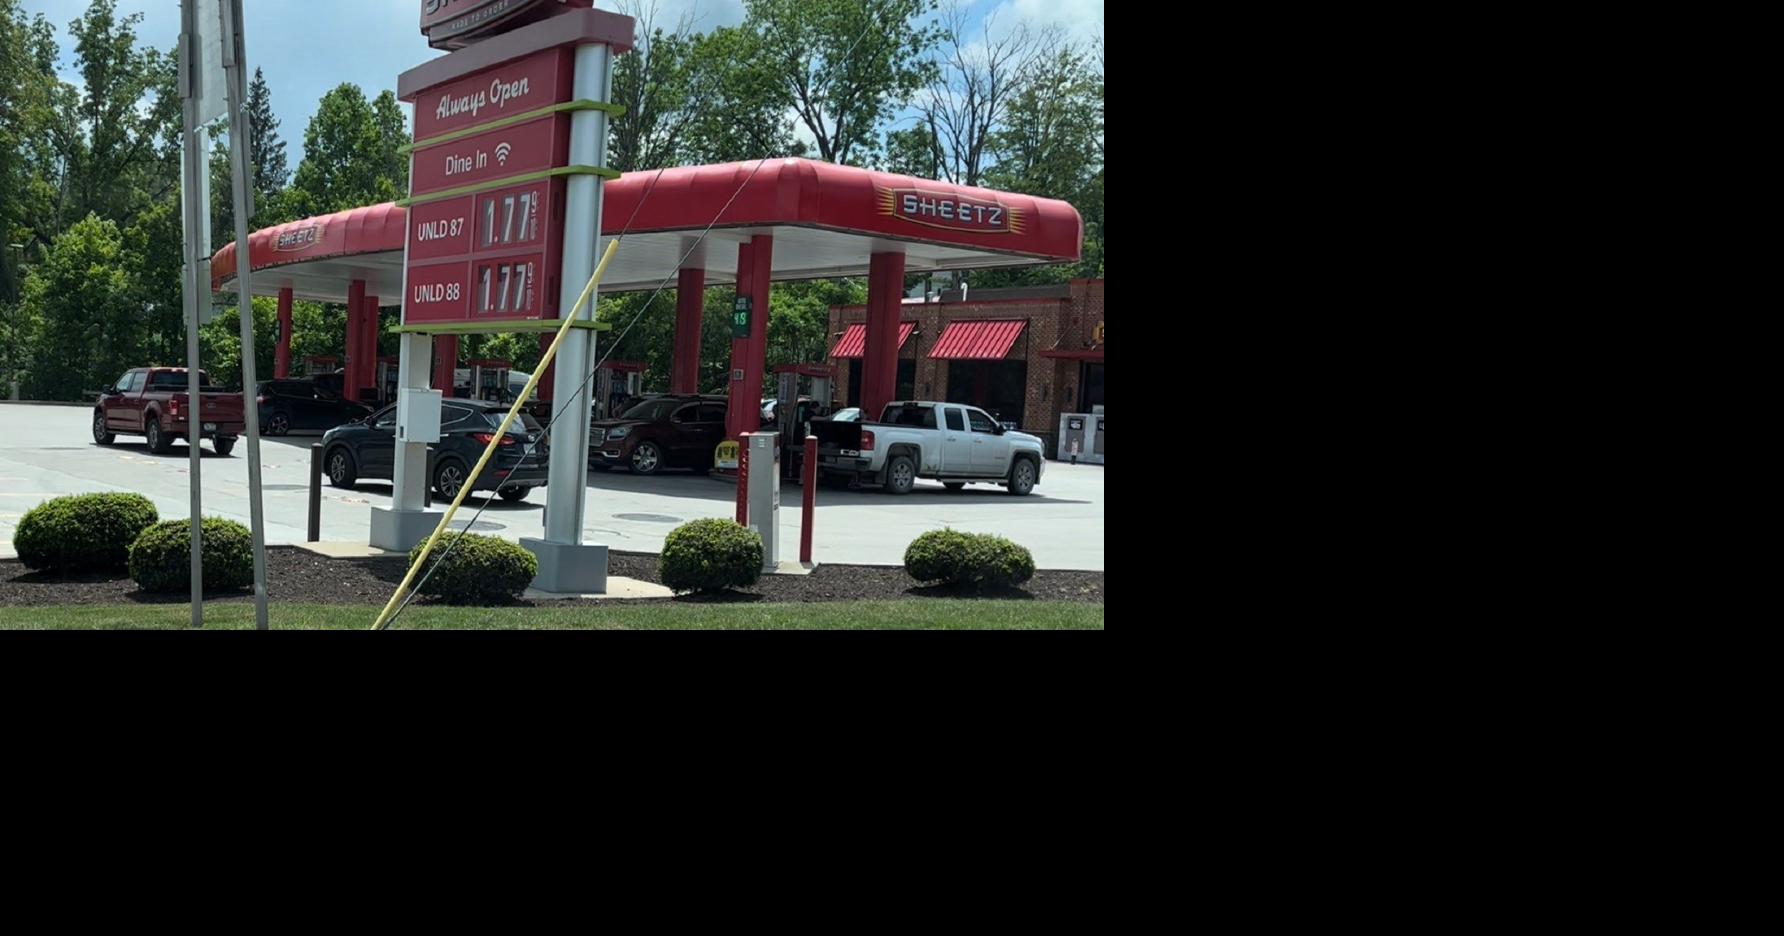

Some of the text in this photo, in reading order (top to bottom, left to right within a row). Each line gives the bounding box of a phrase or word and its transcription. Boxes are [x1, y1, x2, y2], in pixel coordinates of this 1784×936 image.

[436, 77, 529, 120] Always Open
[445, 149, 487, 176] Dine In
[418, 220, 448, 241] UNLD
[450, 218, 464, 237] 87
[487, 194, 531, 243] 1.77
[903, 195, 1002, 224] SHEETZ
[279, 228, 315, 246] SHEETZ
[414, 284, 444, 303] UNLD
[446, 283, 460, 300] 88
[483, 264, 527, 311] 1.77
